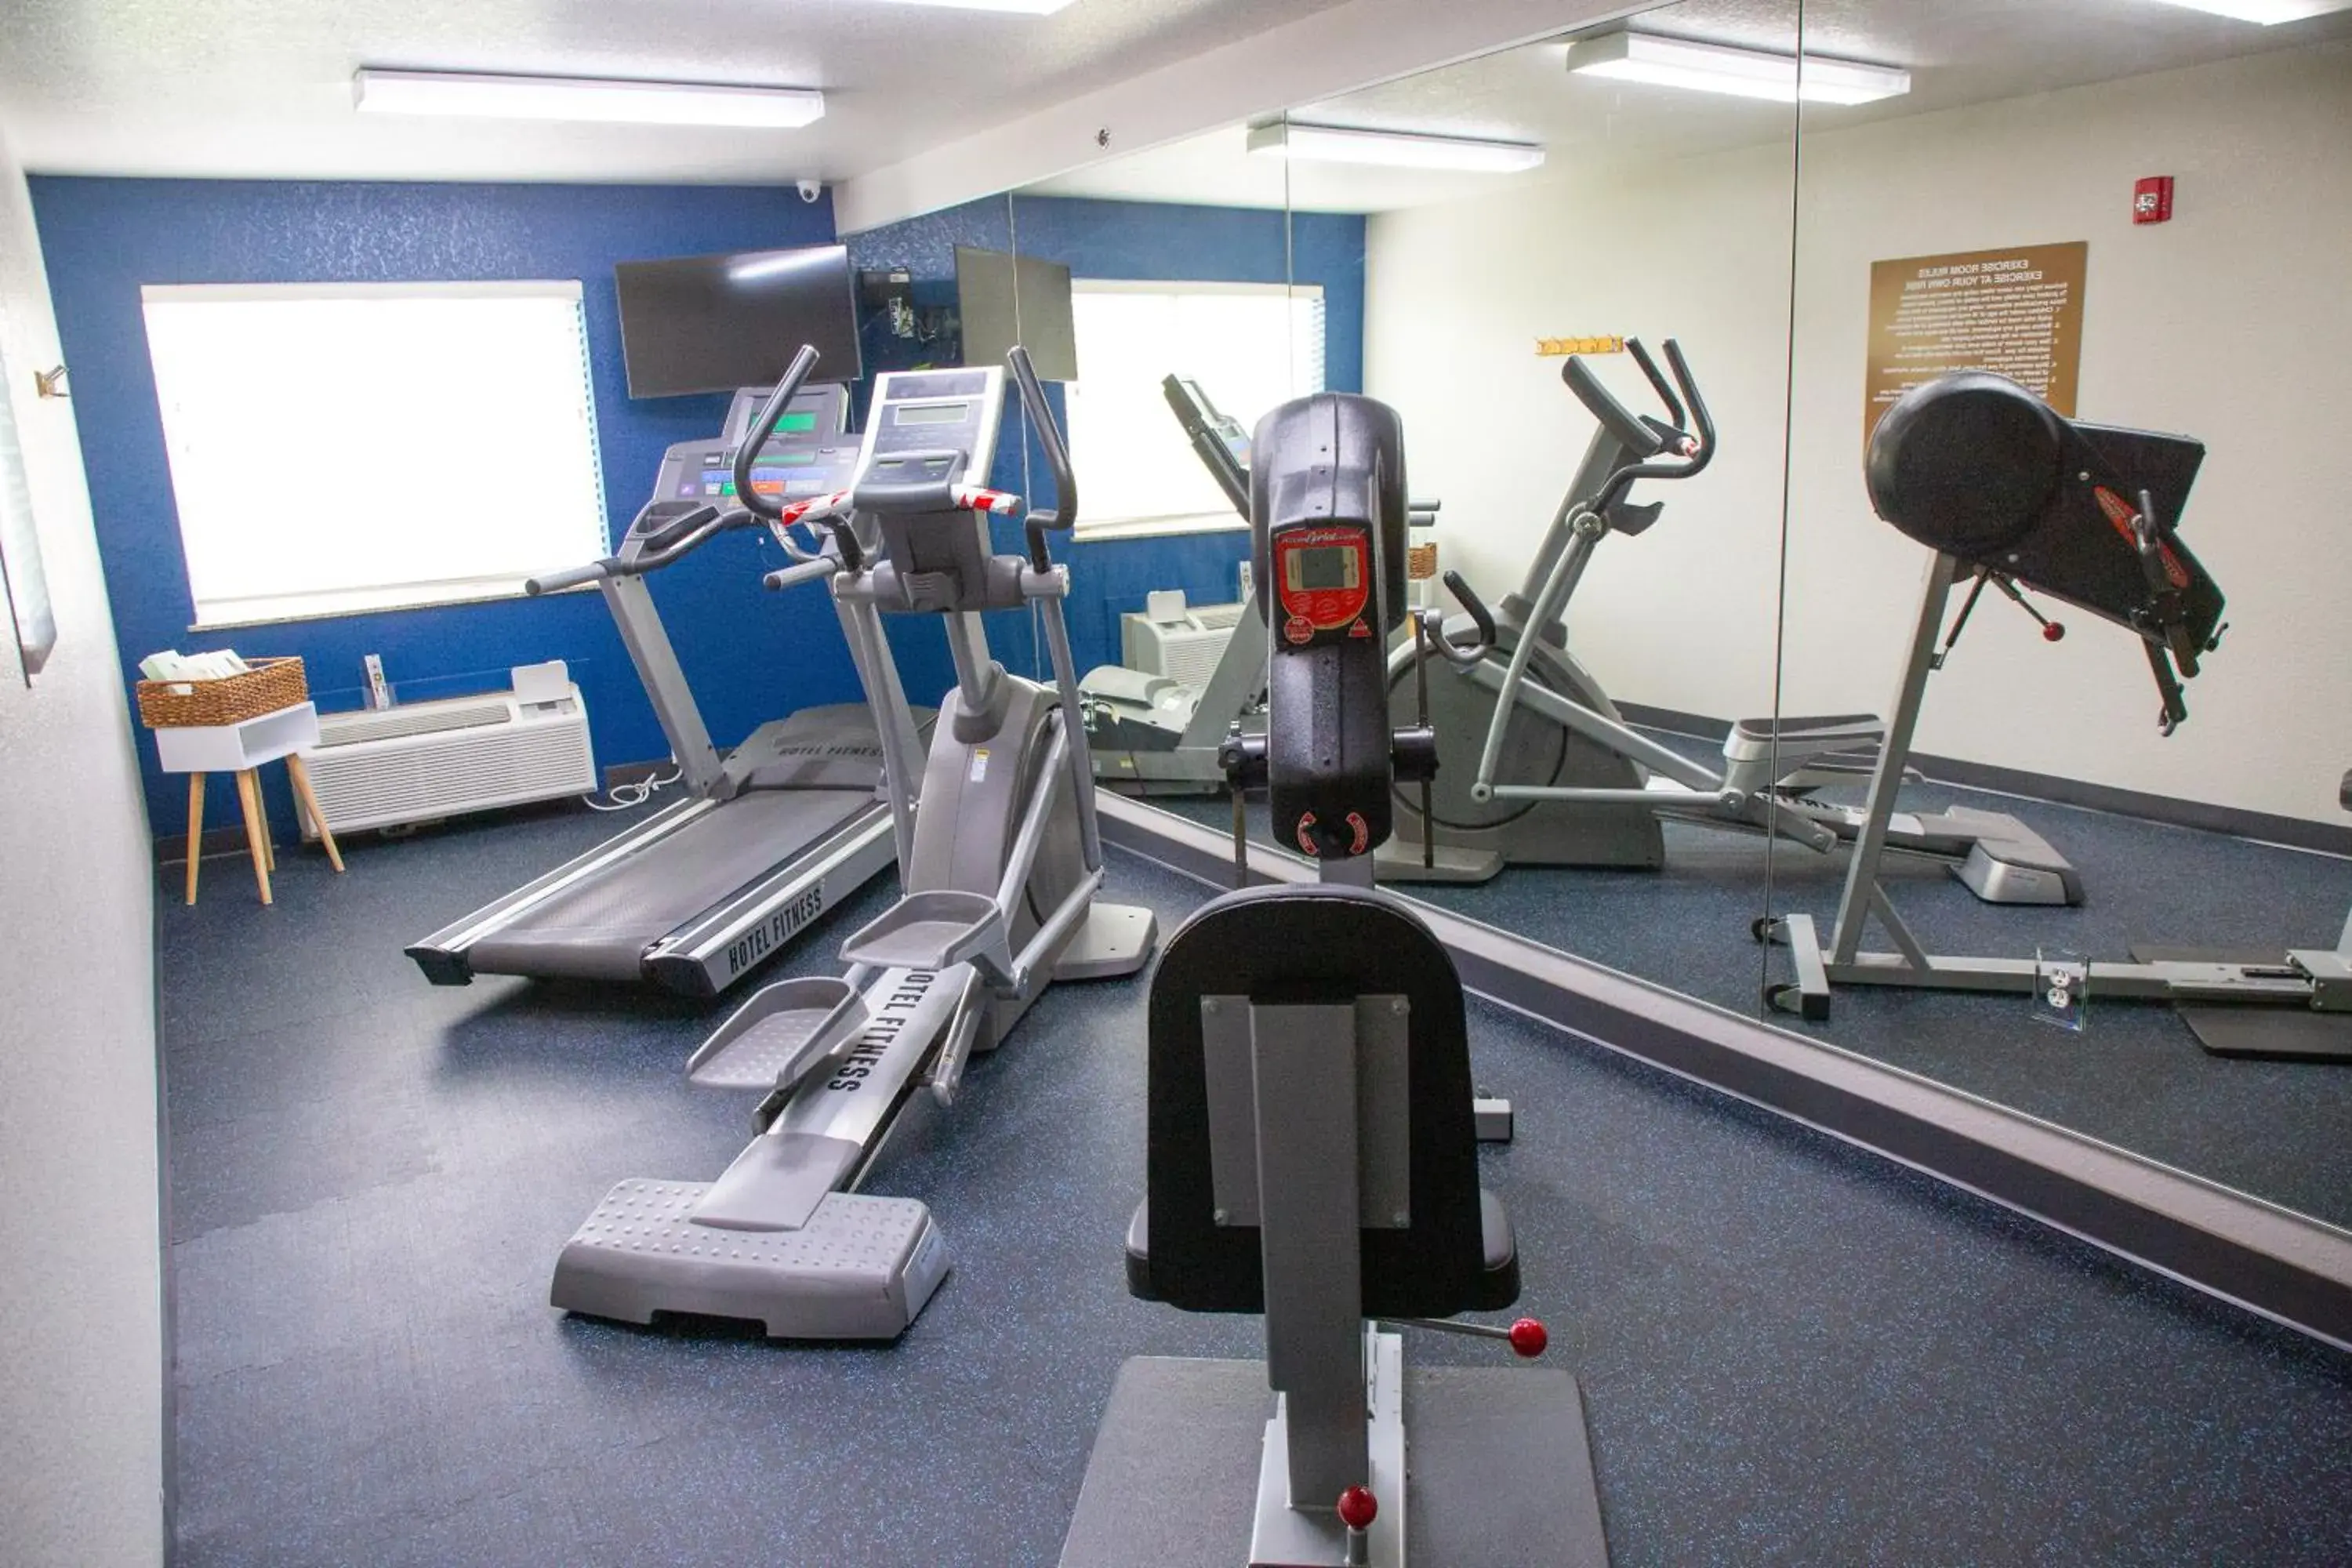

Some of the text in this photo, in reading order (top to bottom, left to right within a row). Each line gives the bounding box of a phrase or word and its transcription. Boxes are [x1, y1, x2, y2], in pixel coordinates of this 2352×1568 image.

[779, 743, 823, 756] HOTEL
[729, 888, 822, 974] HOTEL FITNESS
[827, 1016, 907, 1092] FITNESS
